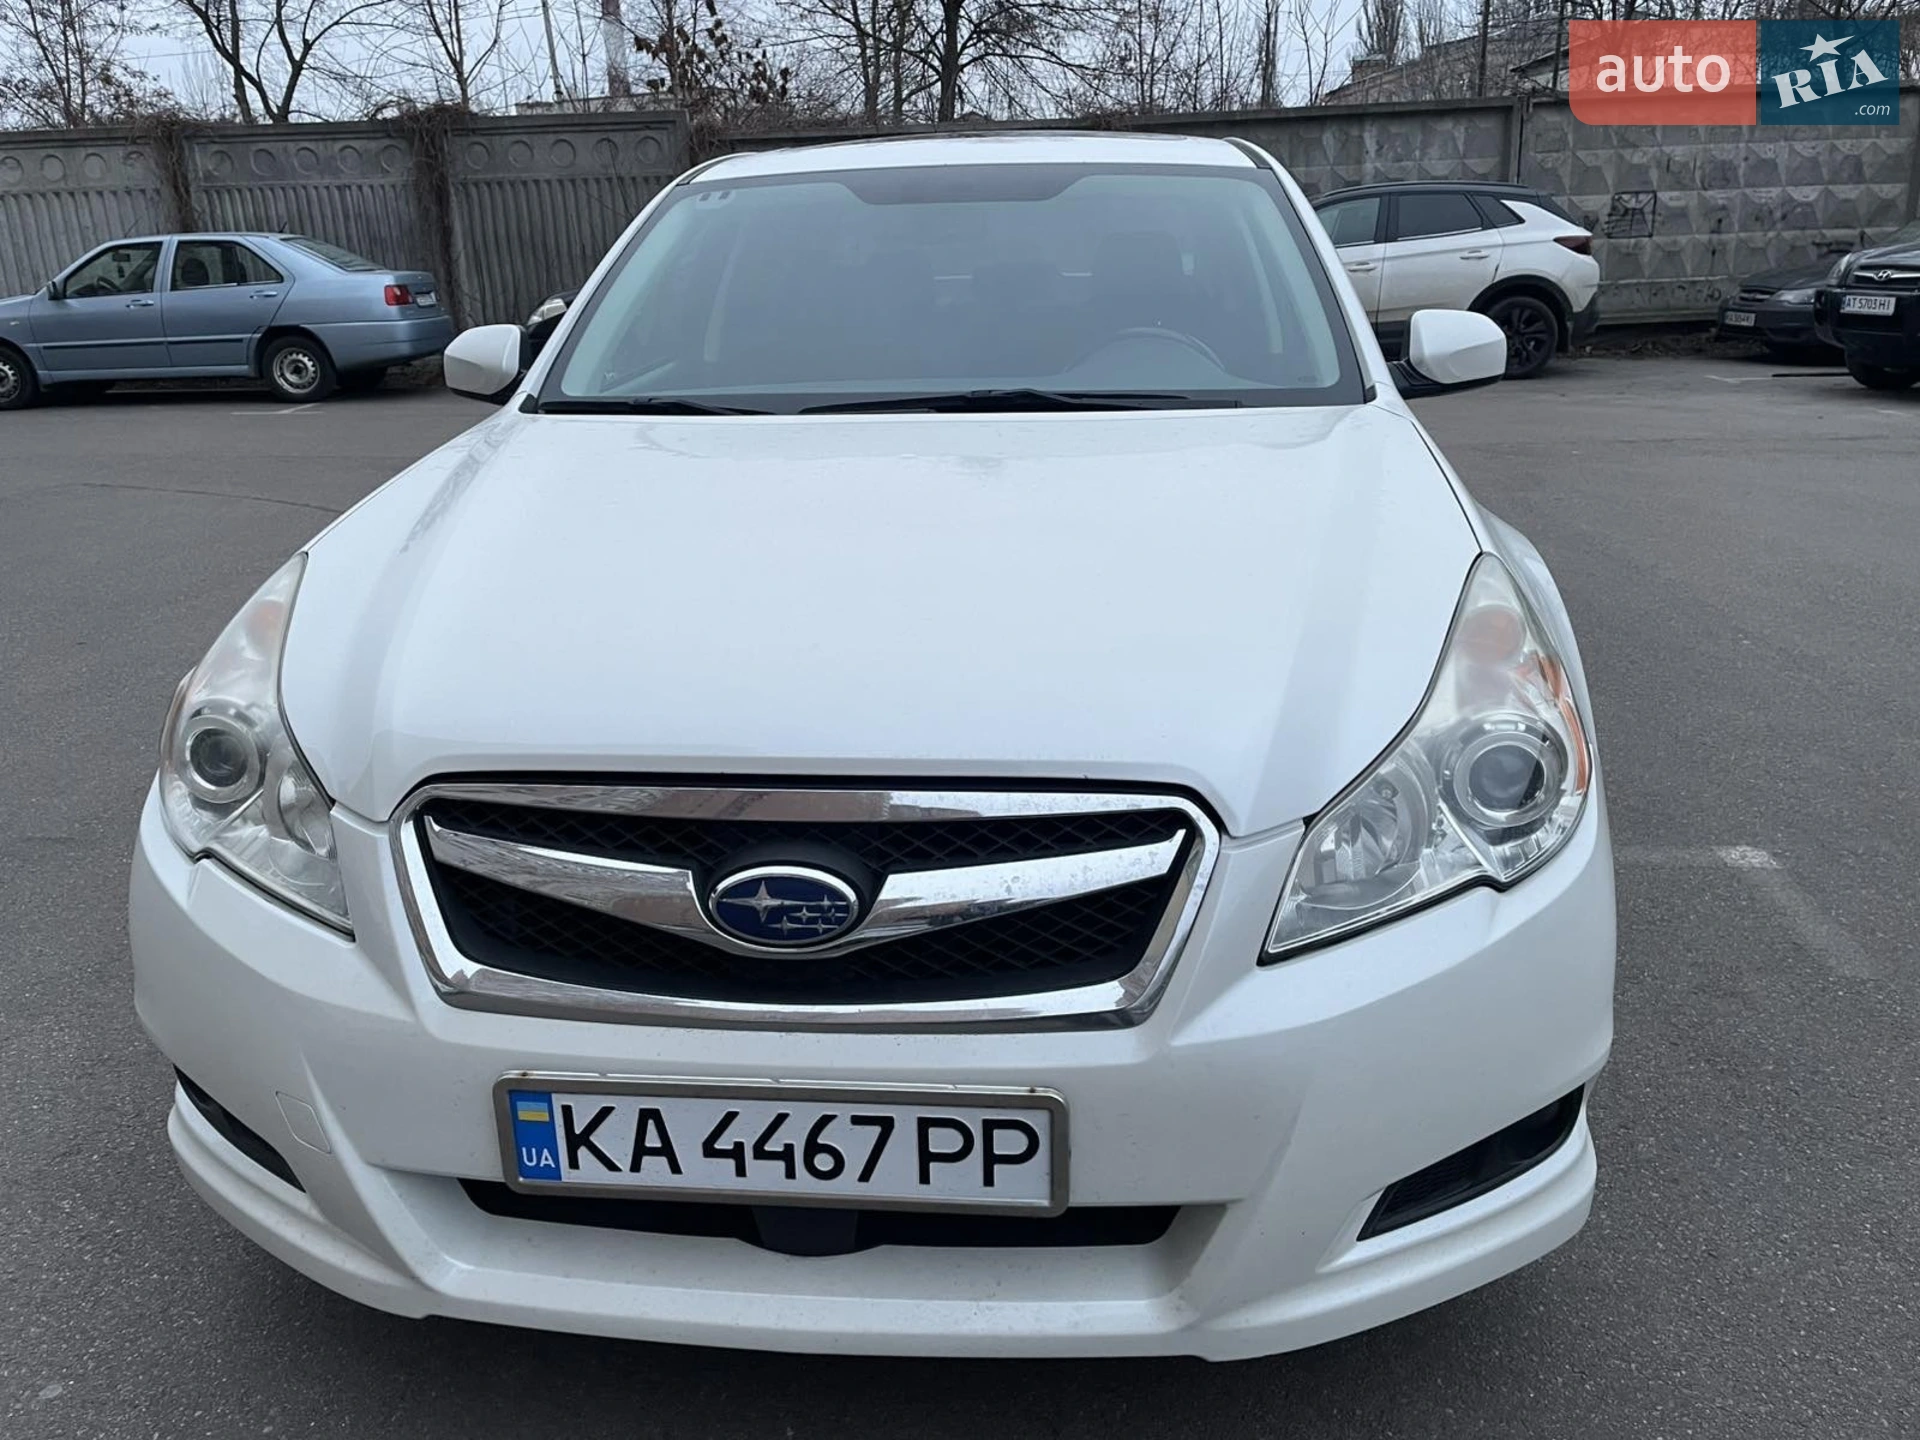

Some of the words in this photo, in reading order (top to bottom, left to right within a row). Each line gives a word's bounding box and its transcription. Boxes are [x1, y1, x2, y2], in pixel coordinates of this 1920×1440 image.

[522, 1147, 555, 1169] UA
[561, 1103, 684, 1175] KA
[702, 1110, 896, 1183] 4467
[916, 1116, 1041, 1188] PP
